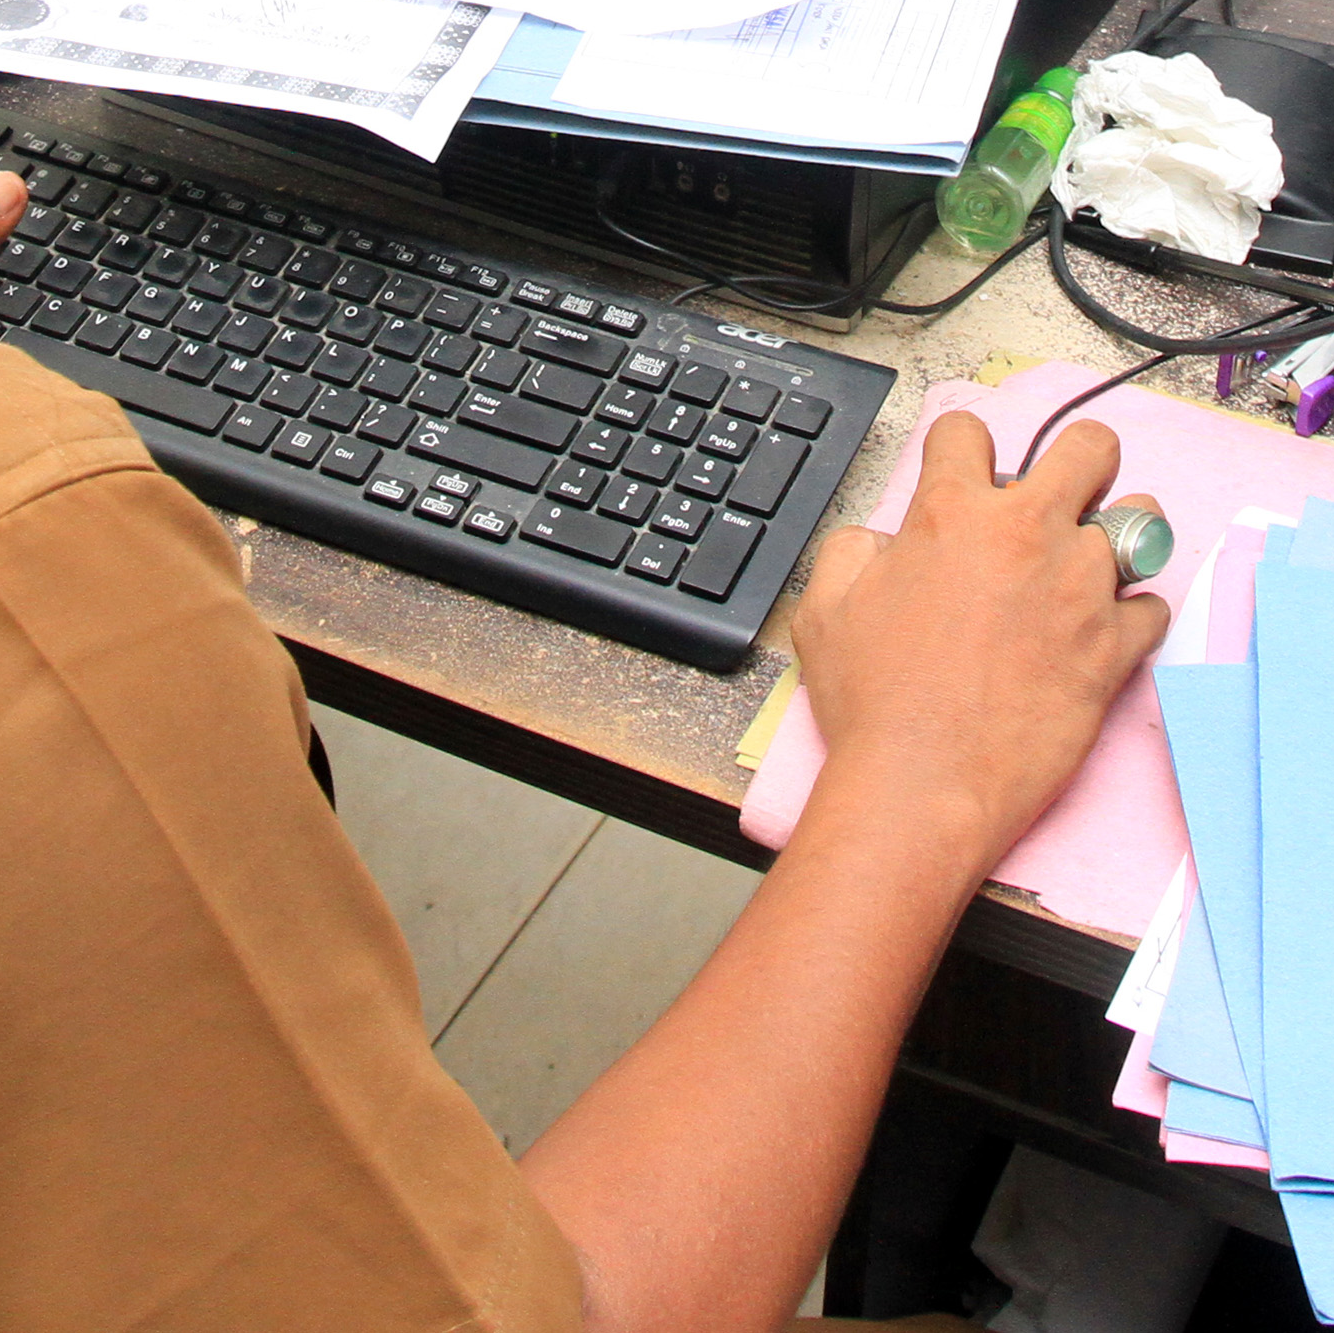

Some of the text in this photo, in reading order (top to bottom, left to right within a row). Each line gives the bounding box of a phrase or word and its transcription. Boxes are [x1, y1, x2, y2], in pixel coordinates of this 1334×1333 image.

[70, 194, 79, 202] 3
[31, 207, 47, 218] W
[72, 221, 85, 231] E
[116, 235, 129, 245] R
[12, 244, 24, 254] S
[163, 249, 174, 258] T
[55, 258, 67, 268] D
[429, 255, 448, 266] F11
[209, 263, 219, 272] Y
[292, 263, 301, 271] 8
[99, 272, 112, 281] F
[471, 266, 490, 279] F12
[252, 277, 265, 287] U
[4, 285, 18, 295] X
[145, 287, 157, 298] G
[519, 287, 547, 301] Break
[521, 282, 550, 297] Pause
[298, 291, 305, 300] I
[385, 291, 394, 300] 0
[49, 300, 61, 310] C
[189, 301, 203, 311] H
[345, 306, 358, 316] O
[605, 306, 637, 322] Delete
[96, 314, 107, 324] V
[236, 317, 247, 325] J
[391, 320, 404, 329] P
[138, 328, 151, 339] B
[282, 330, 296, 341] K
[538, 321, 589, 341] Backspace
[717, 323, 799, 349] acer
[184, 344, 199, 355] N
[329, 345, 337, 356] L
[231, 358, 247, 371] M
[632, 353, 667, 369] NumLk
[625, 390, 635, 399] 7
[473, 393, 501, 407] Enter
[605, 404, 633, 417] Home
[676, 406, 686, 415] 8
[237, 417, 252, 426] Alt
[727, 422, 737, 431] 9
[426, 421, 449, 433] Shift
[601, 429, 610, 438] 4
[709, 435, 736, 449] PgUp
[335, 449, 354, 459] Ctrl
[652, 444, 662, 454] 5
[704, 460, 714, 470] 6
[579, 468, 585, 477] 1
[560, 482, 581, 494] End
[627, 484, 638, 494] 2
[680, 501, 691, 511] 3
[551, 508, 561, 518] 0
[661, 515, 689, 529] PgDn
[723, 512, 751, 527] Enter
[537, 524, 552, 534] Ins
[642, 557, 661, 569] Del
